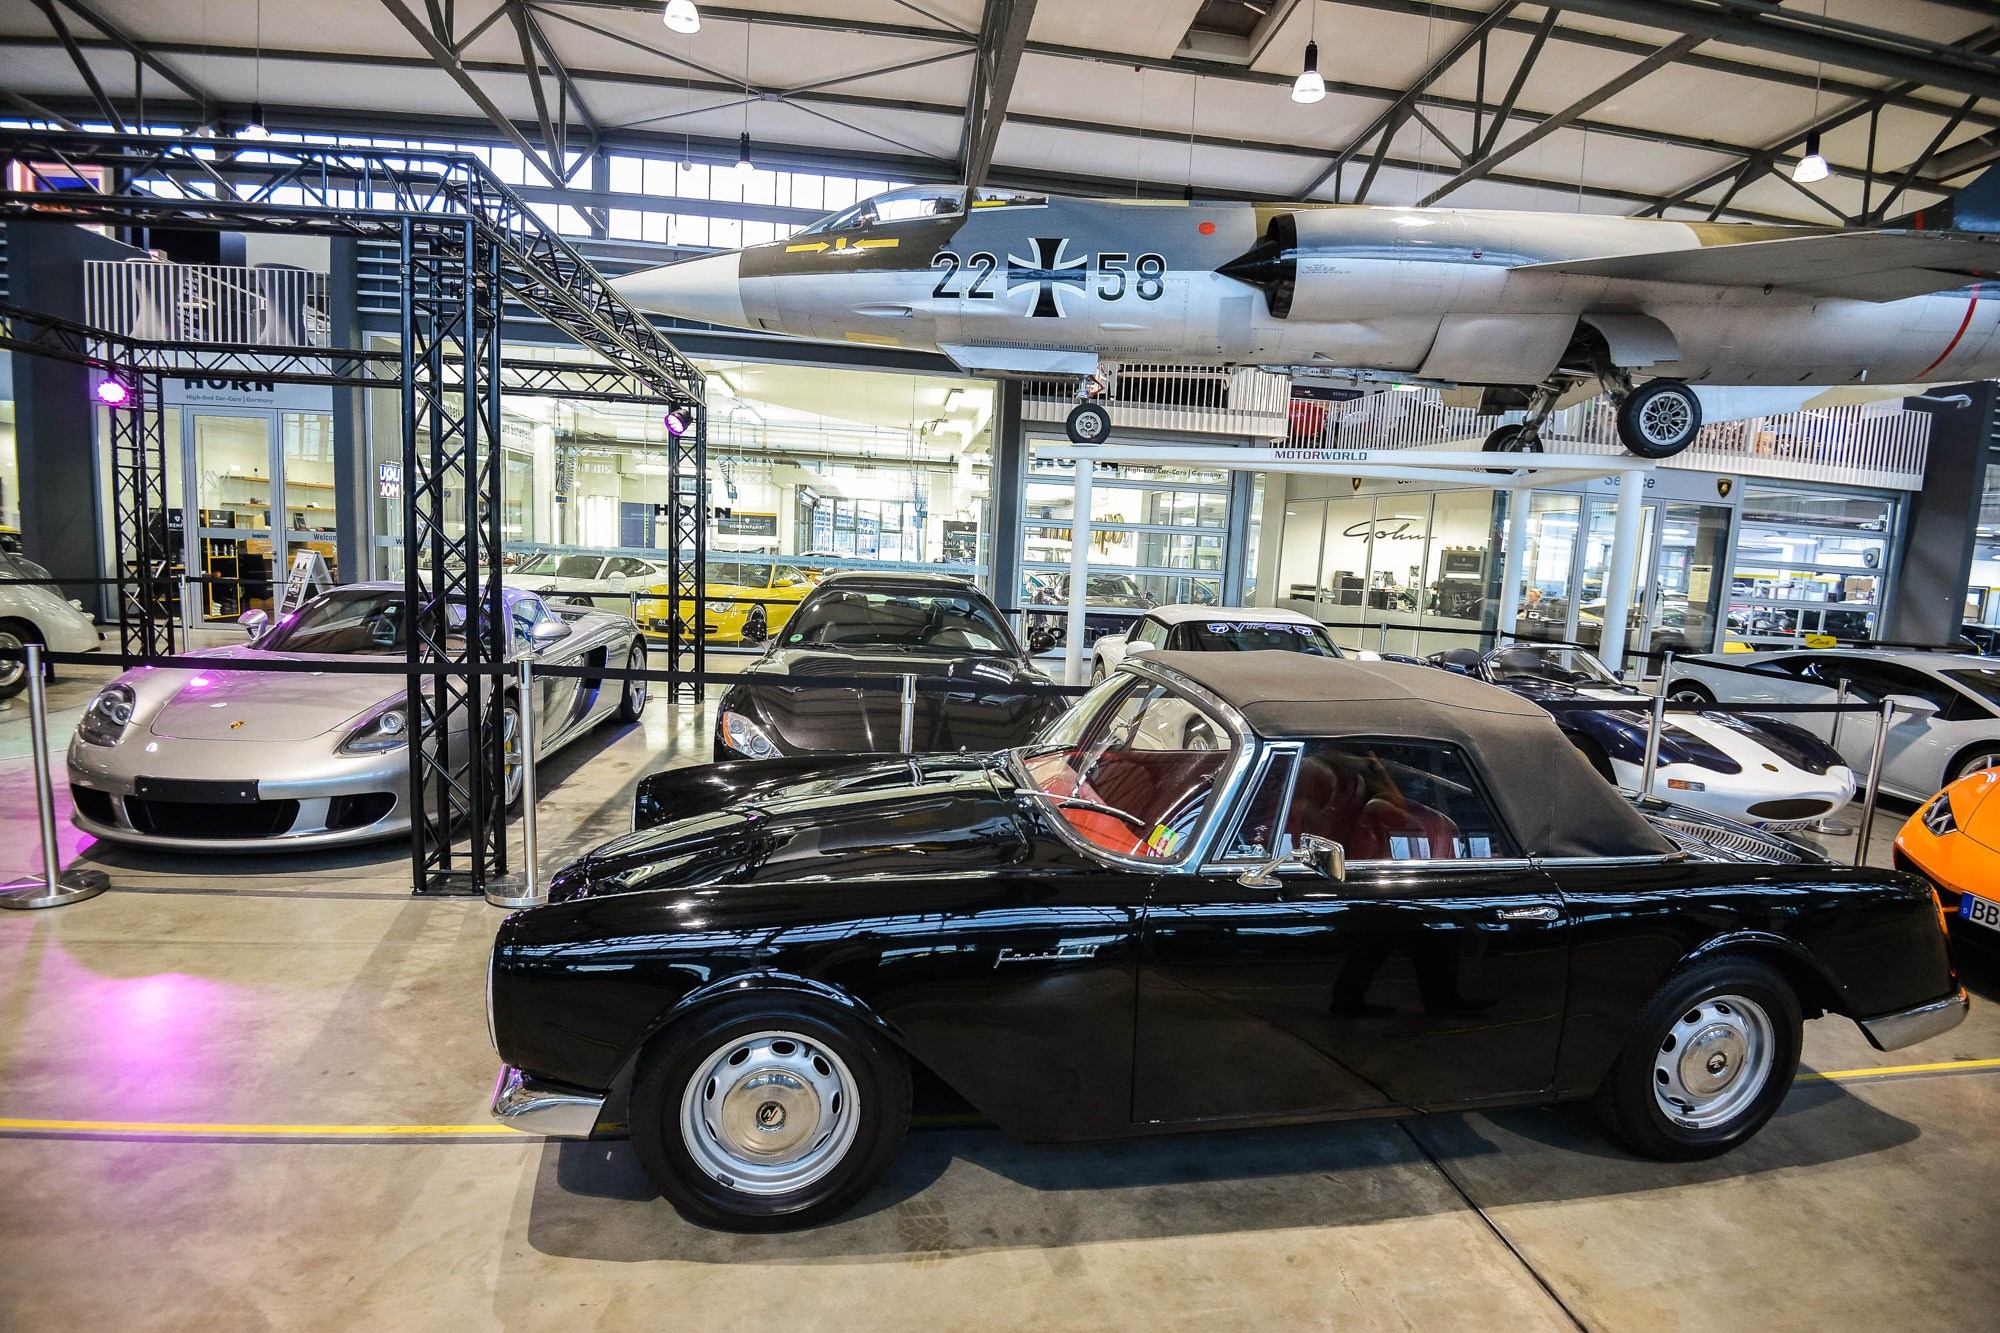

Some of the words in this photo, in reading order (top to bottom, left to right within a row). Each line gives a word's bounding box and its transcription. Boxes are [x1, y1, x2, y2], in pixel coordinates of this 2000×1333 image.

[931, 251, 998, 300] 22
[1096, 252, 1167, 302] 58
[1275, 450, 1368, 461] MOTORWORLD
[1036, 457, 1119, 472] HON
[1157, 468, 1187, 476] Car-Care
[1192, 470, 1222, 479] Germany
[1226, 622, 1293, 634] VIPER
[1971, 900, 2000, 925] BB
